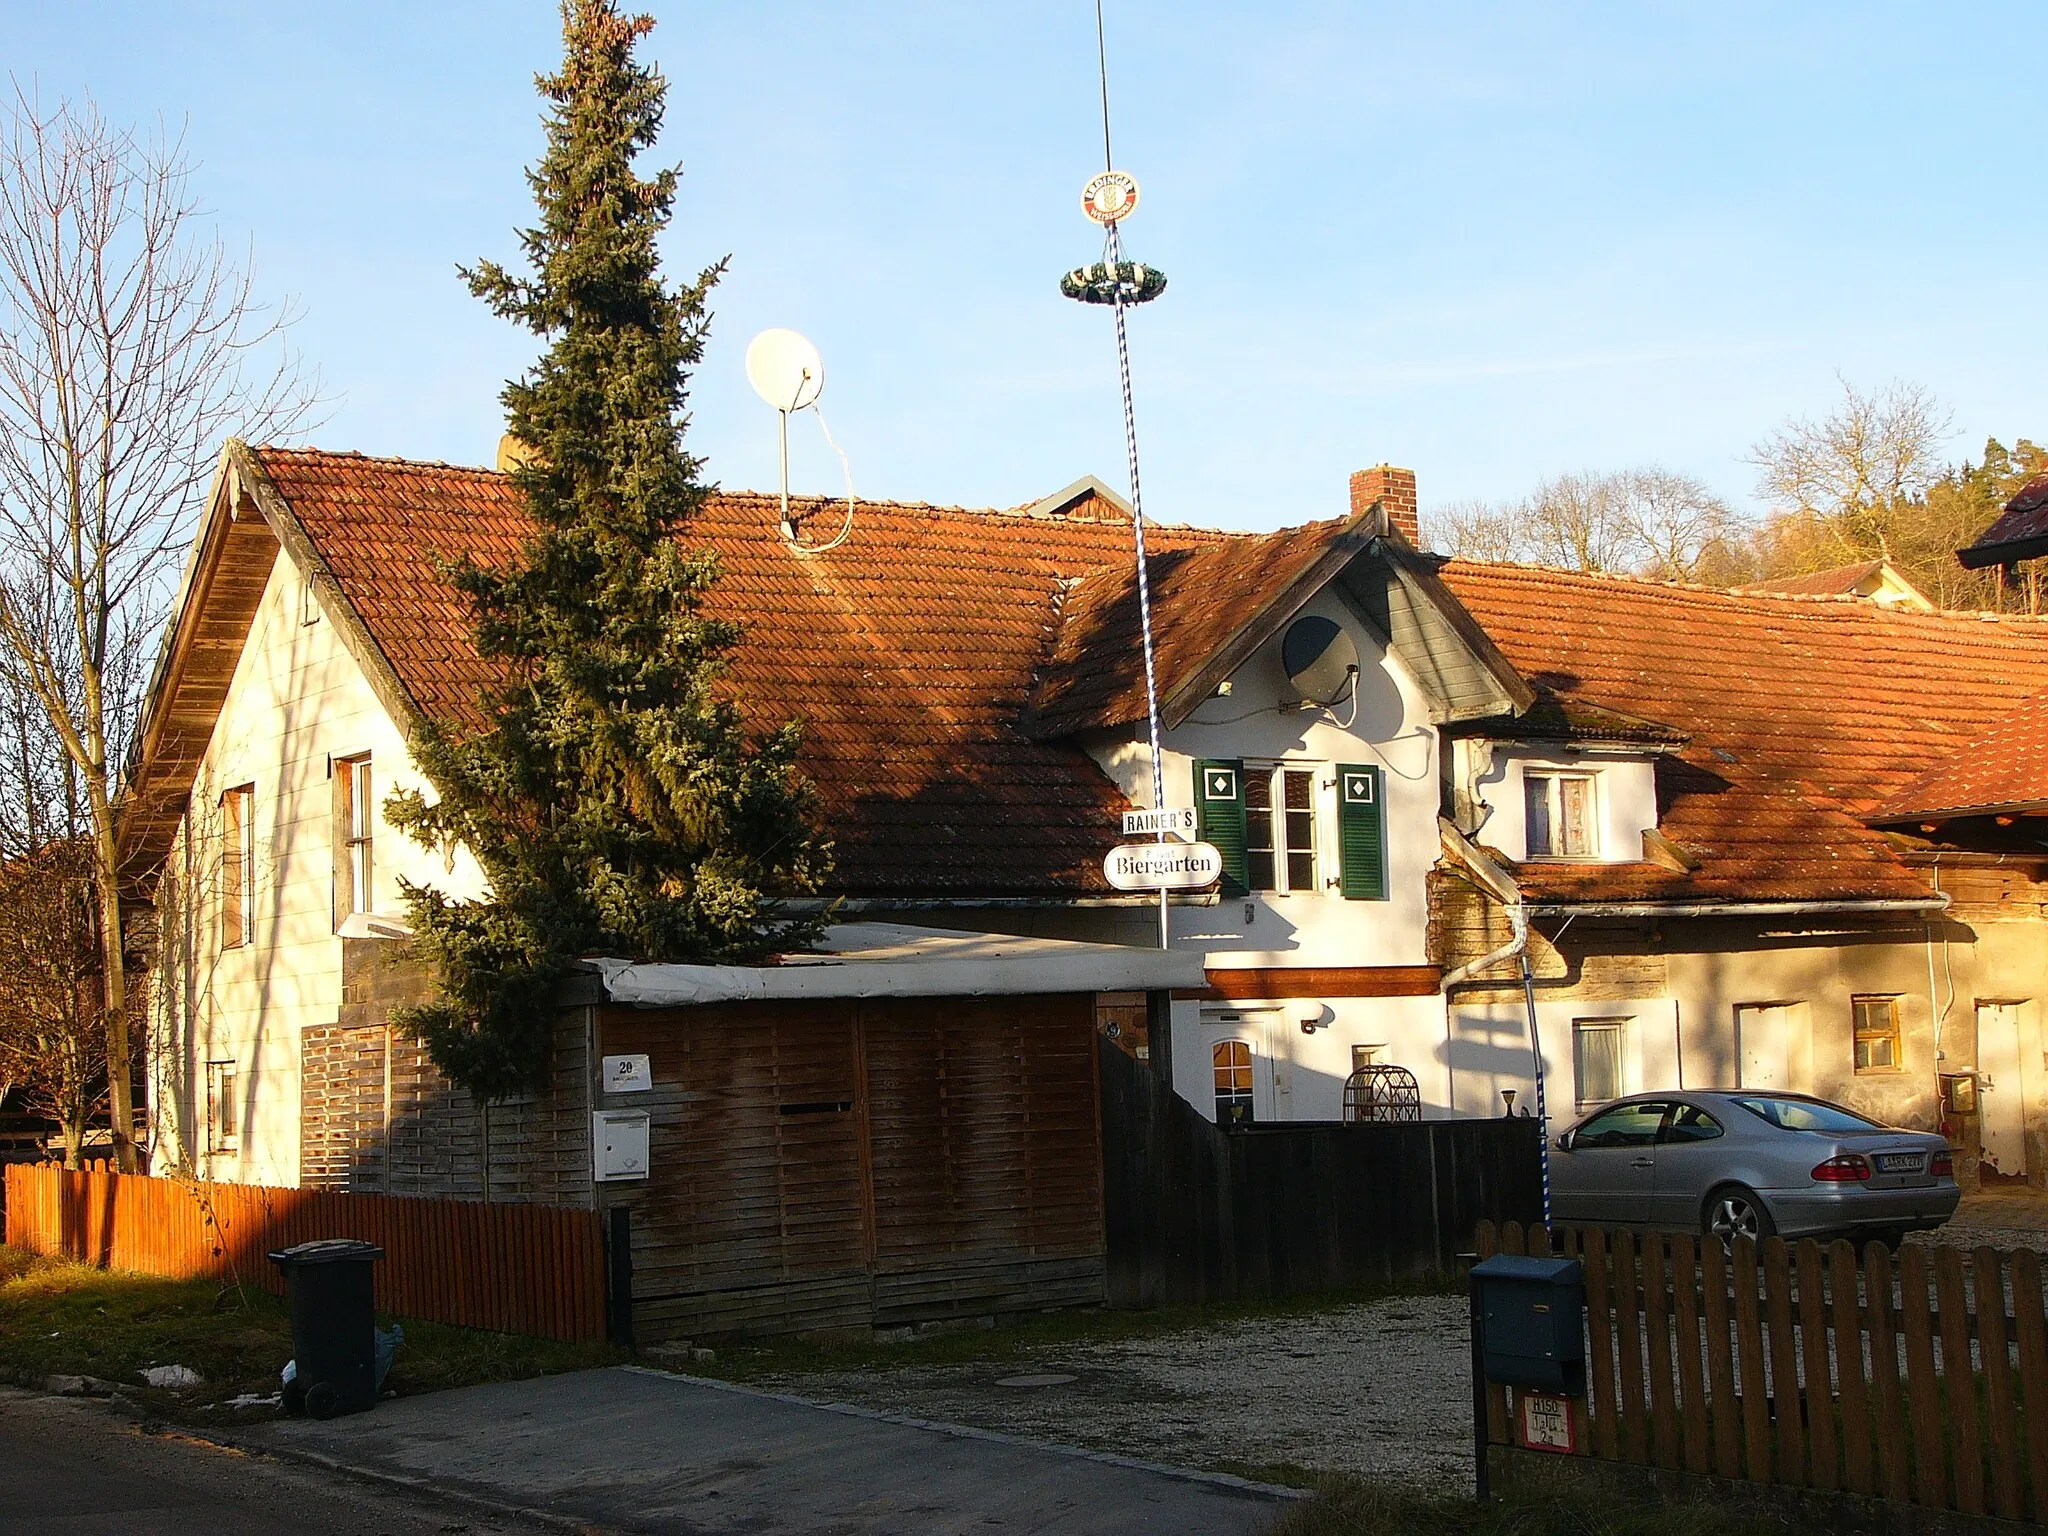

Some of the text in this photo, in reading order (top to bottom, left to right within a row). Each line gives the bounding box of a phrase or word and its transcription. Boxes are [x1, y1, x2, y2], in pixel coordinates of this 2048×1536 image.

[1085, 174, 1134, 199] ERDINGER
[1127, 811, 1193, 832] RAINER'S
[1116, 855, 1212, 878] Biergarten
[619, 1061, 633, 1074] 20
[1533, 1398, 1558, 1413] H150
